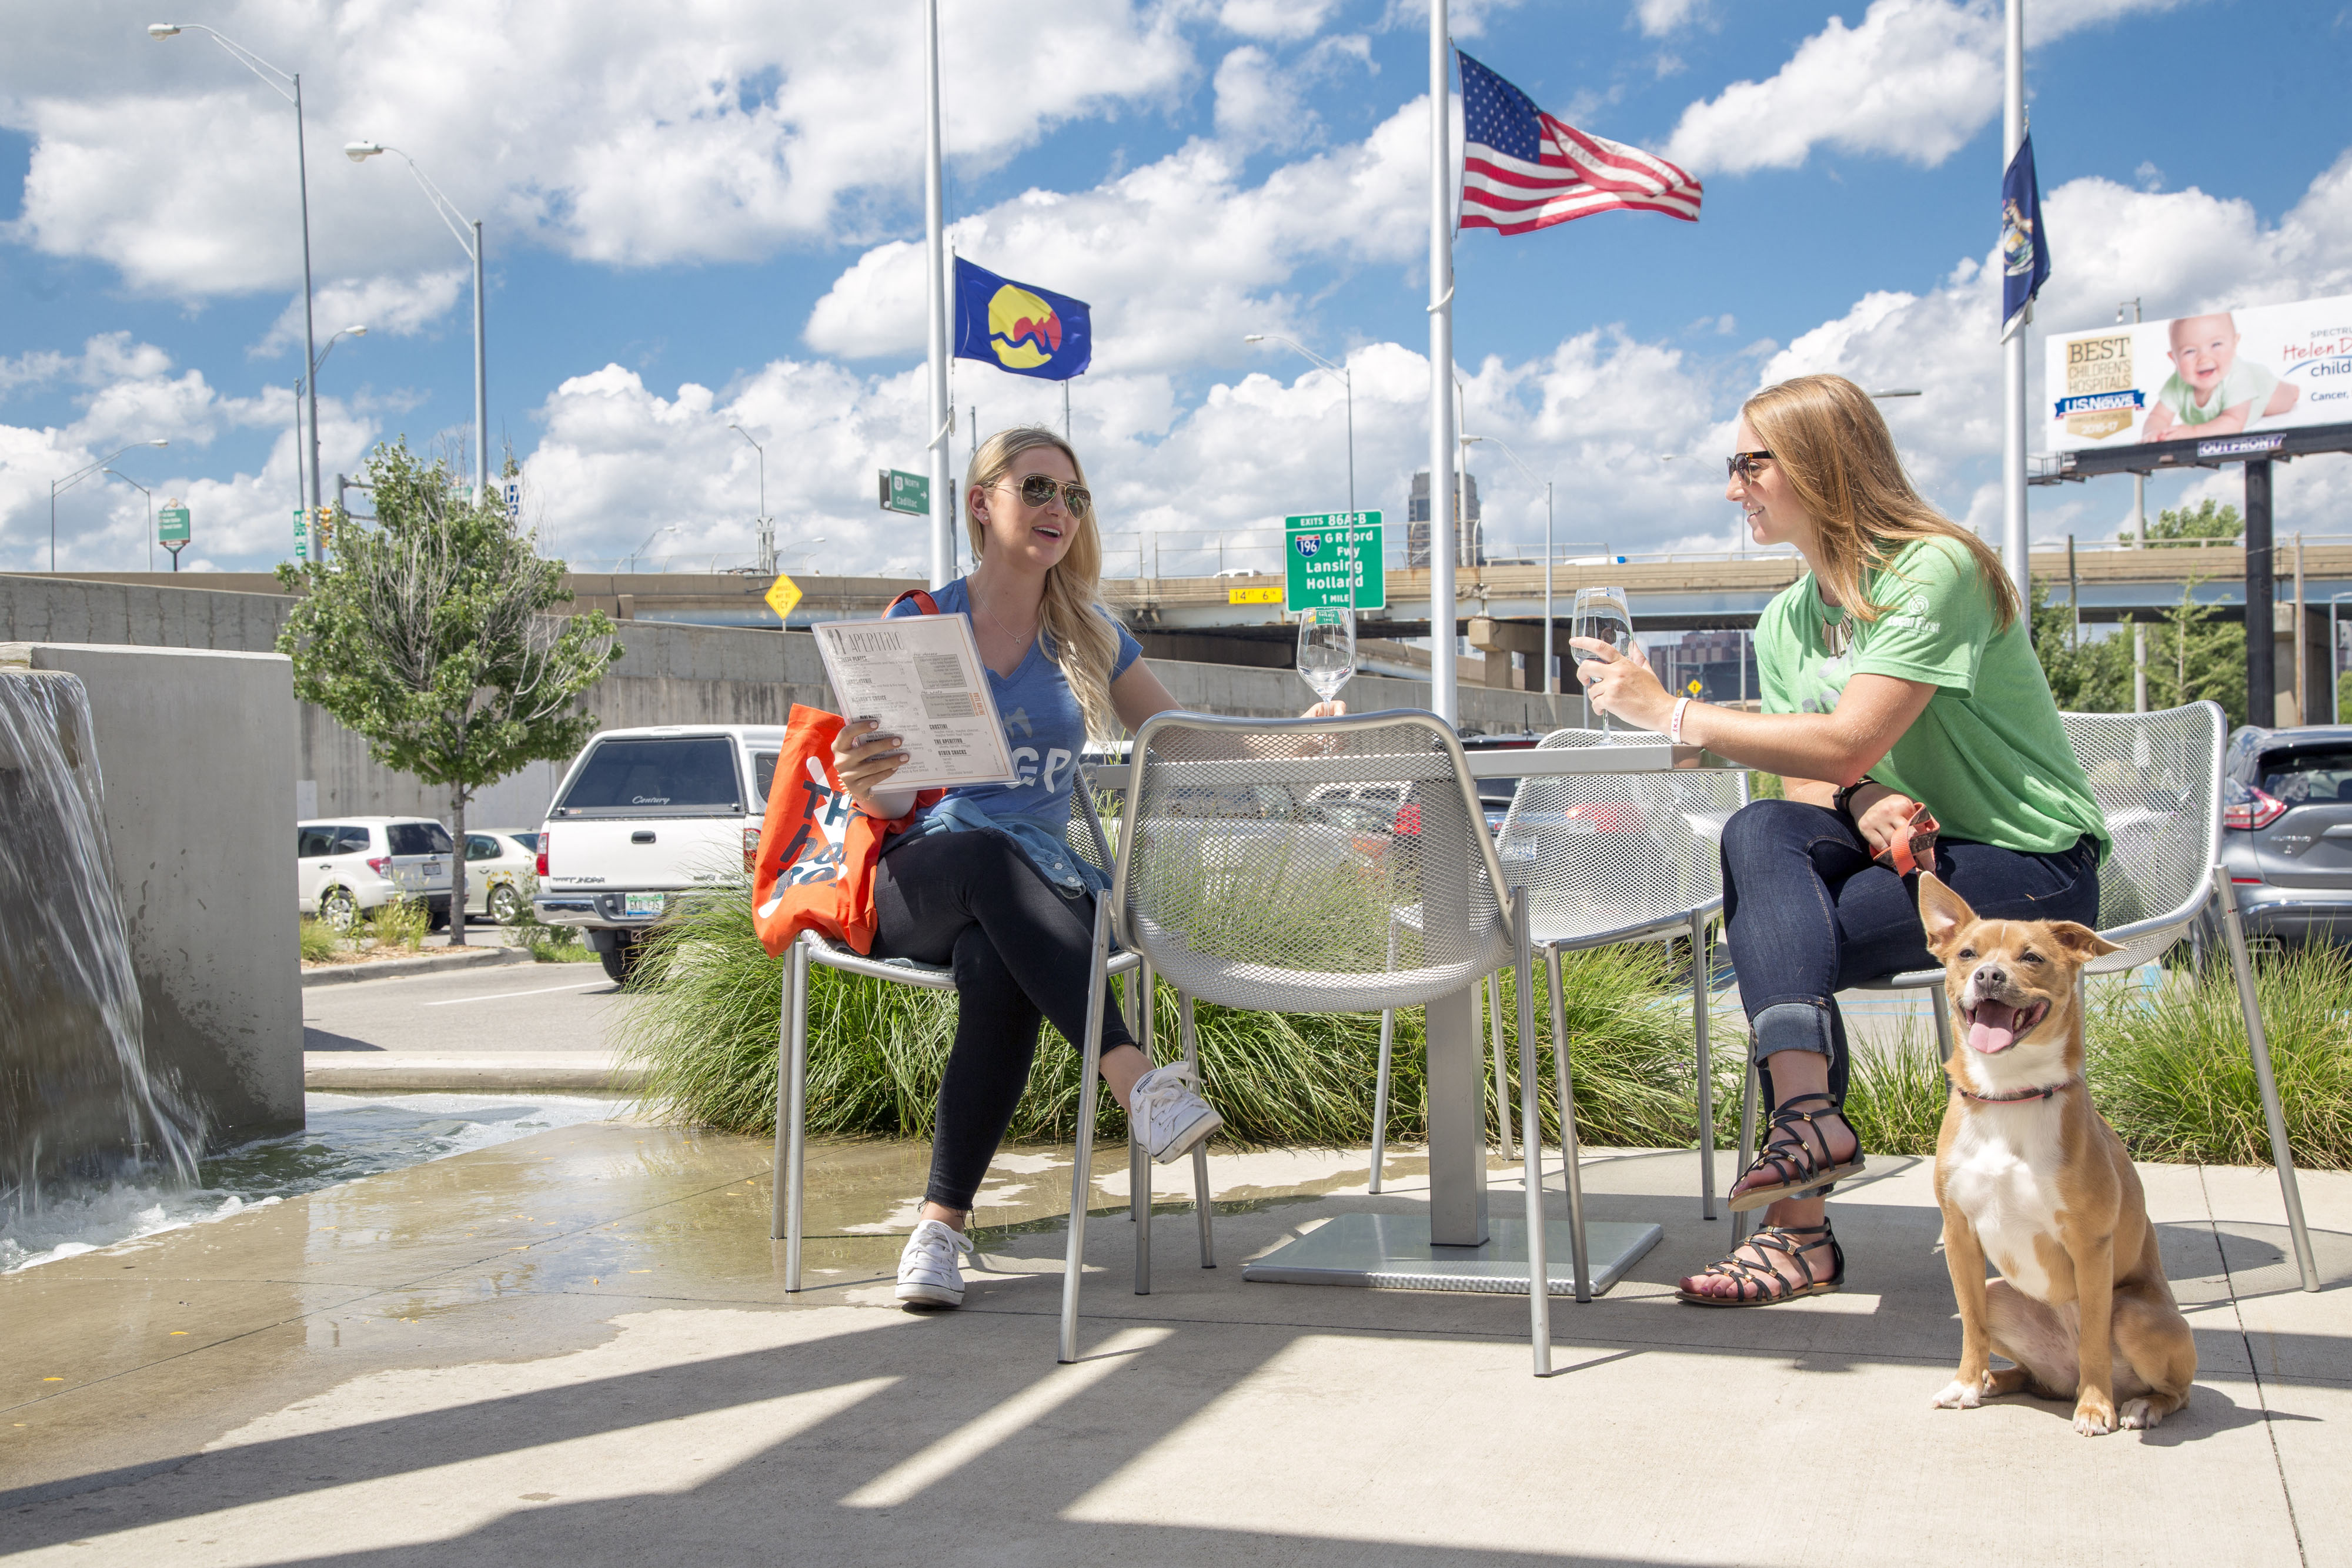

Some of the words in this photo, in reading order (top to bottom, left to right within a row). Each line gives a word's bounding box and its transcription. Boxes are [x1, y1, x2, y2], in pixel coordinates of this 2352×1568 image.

[2070, 337, 2130, 363] BEST
[2283, 341, 2334, 362] Helen
[2069, 359, 2131, 379] CHILDREN'S
[2311, 359, 2351, 377] child
[2069, 375, 2131, 394] HOSPITALS
[2311, 392, 2349, 402] Cancer,
[896, 496, 917, 508] Cadillac
[1300, 517, 1324, 526] EXITS
[1328, 513, 1367, 526] 86A-B
[1325, 533, 1333, 543] G
[1335, 532, 1343, 543] R
[1345, 530, 1374, 541] Ford
[1300, 540, 1318, 553] 196
[1337, 546, 1360, 559] Fwy
[1306, 559, 1363, 573] Lansing
[1306, 574, 1364, 590] Holland
[1235, 591, 1246, 601] 14
[1262, 590, 1268, 600] 6
[1330, 594, 1349, 603] MILE
[777, 600, 789, 609] ICY
[1887, 614, 1915, 629] Local
[1915, 616, 1941, 634] First
[848, 631, 905, 653] APERITIVO
[632, 795, 670, 804] Century
